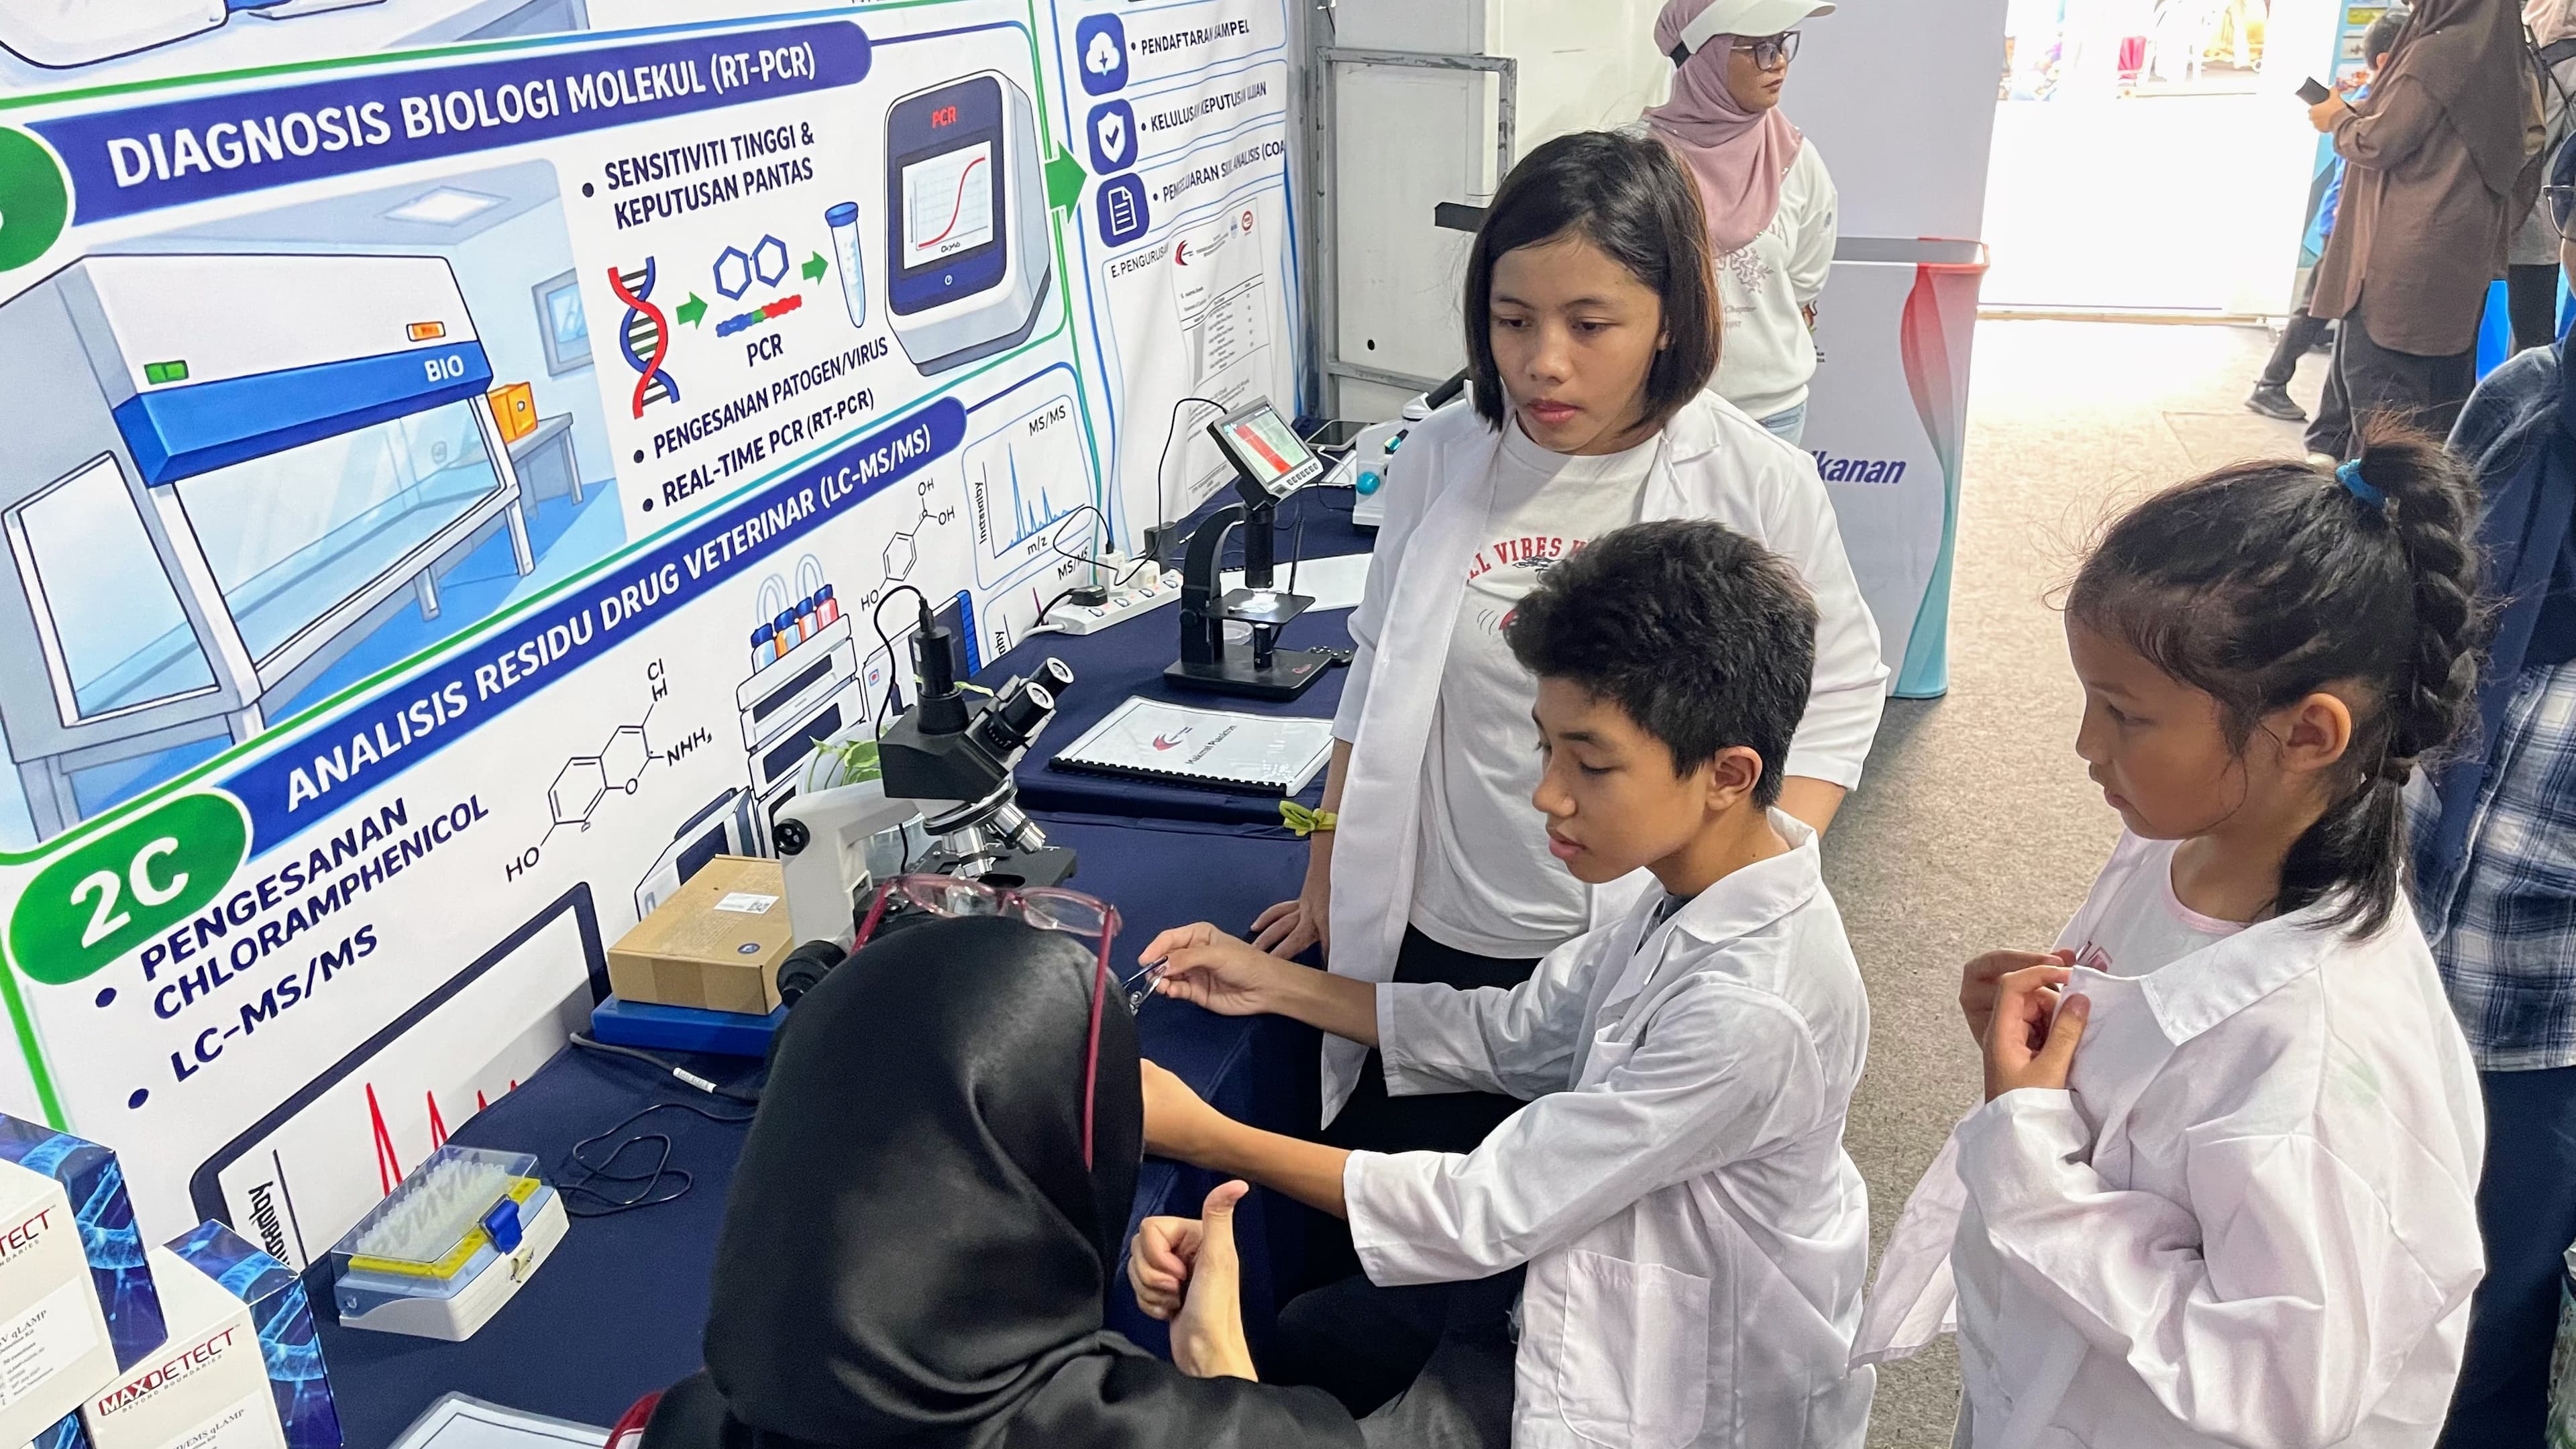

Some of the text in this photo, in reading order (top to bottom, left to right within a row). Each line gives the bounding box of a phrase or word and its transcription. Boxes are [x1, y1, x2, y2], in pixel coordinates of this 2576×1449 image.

[107, 42, 816, 189] DIAGNOSIS BIOLOGI MOLEKUL (RT-PCR)
[932, 105, 957, 129] PCR
[604, 121, 814, 192] SENSITIVITI TINGGI &
[614, 157, 814, 229] KEPUTUSAN PANTAS
[1111, 265, 1120, 278] E.
[747, 333, 784, 367] PCR
[425, 355, 464, 382] BIO
[653, 337, 888, 458] PENGESANAN PATOGEN/VIRUS
[1029, 405, 1066, 436] MS/MS
[662, 388, 873, 507] REAL-TIME PCR (RT-PCR)
[1812, 451, 1907, 484] kanan
[918, 478, 934, 496] OH
[938, 506, 955, 525] OH
[1028, 535, 1047, 555] m/z
[1493, 537, 1562, 565] VIBES
[861, 589, 879, 611] HO
[287, 423, 931, 812] ANALISIS RESIDU DRUG VETERINAR (LC-MS/MS)
[505, 847, 540, 882] HO
[70, 837, 191, 949] 2C
[141, 798, 409, 981] PENGESANAN
[153, 794, 490, 1020] CHLORAMPHENICOL
[170, 923, 378, 1082] LC-MS/MS
[11, 1309, 47, 1340] qLAMP
[98, 1327, 234, 1417] MAXDETECT
[164, 1355, 223, 1390] BOUNDARIES
[210, 1409, 245, 1434] qLAMP
